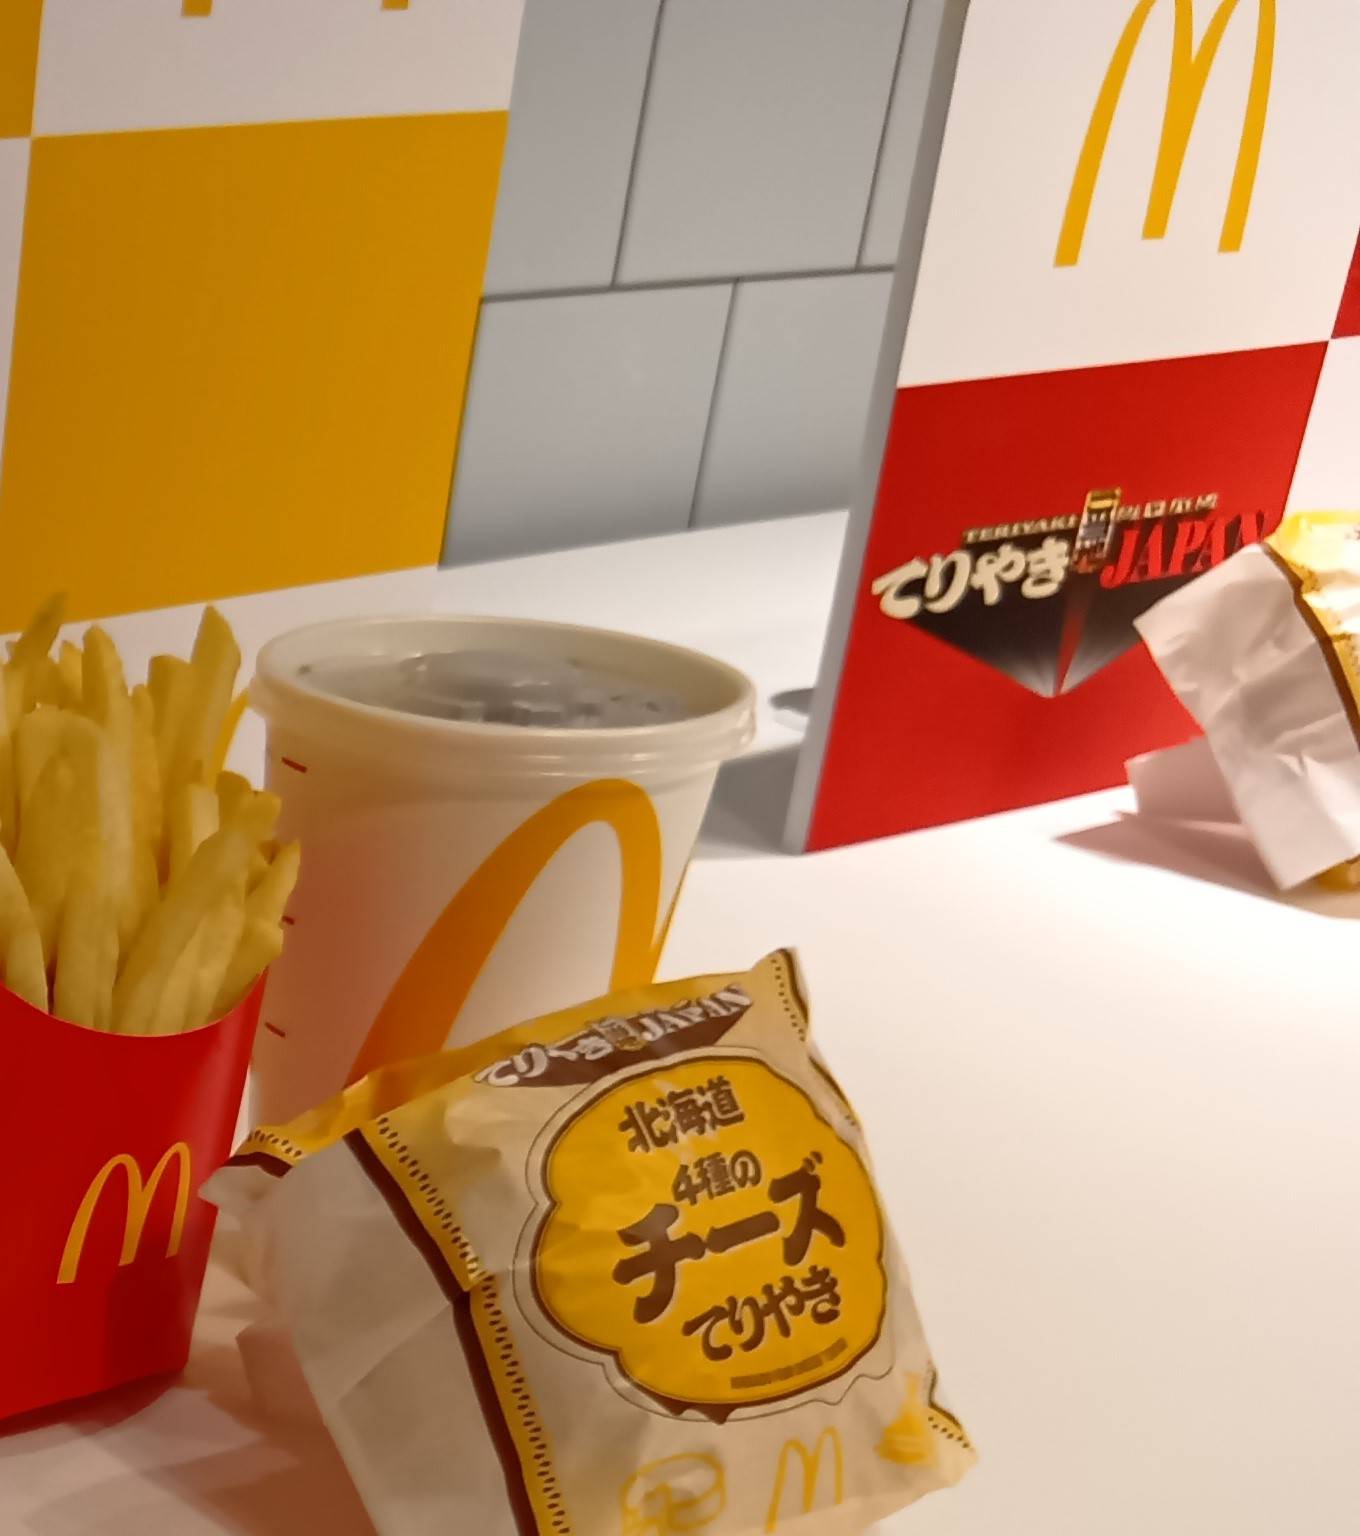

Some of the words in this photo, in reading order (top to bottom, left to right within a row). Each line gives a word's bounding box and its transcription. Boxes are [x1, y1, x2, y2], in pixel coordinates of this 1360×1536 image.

[871, 535, 1070, 620] てりやき
[639, 984, 753, 1042] JAPAN
[618, 1075, 745, 1153] 北海道
[56, 1141, 191, 1285] M
[672, 1150, 762, 1206] 4種の
[612, 1151, 846, 1323] チーズ
[683, 1266, 841, 1362] てりやき
